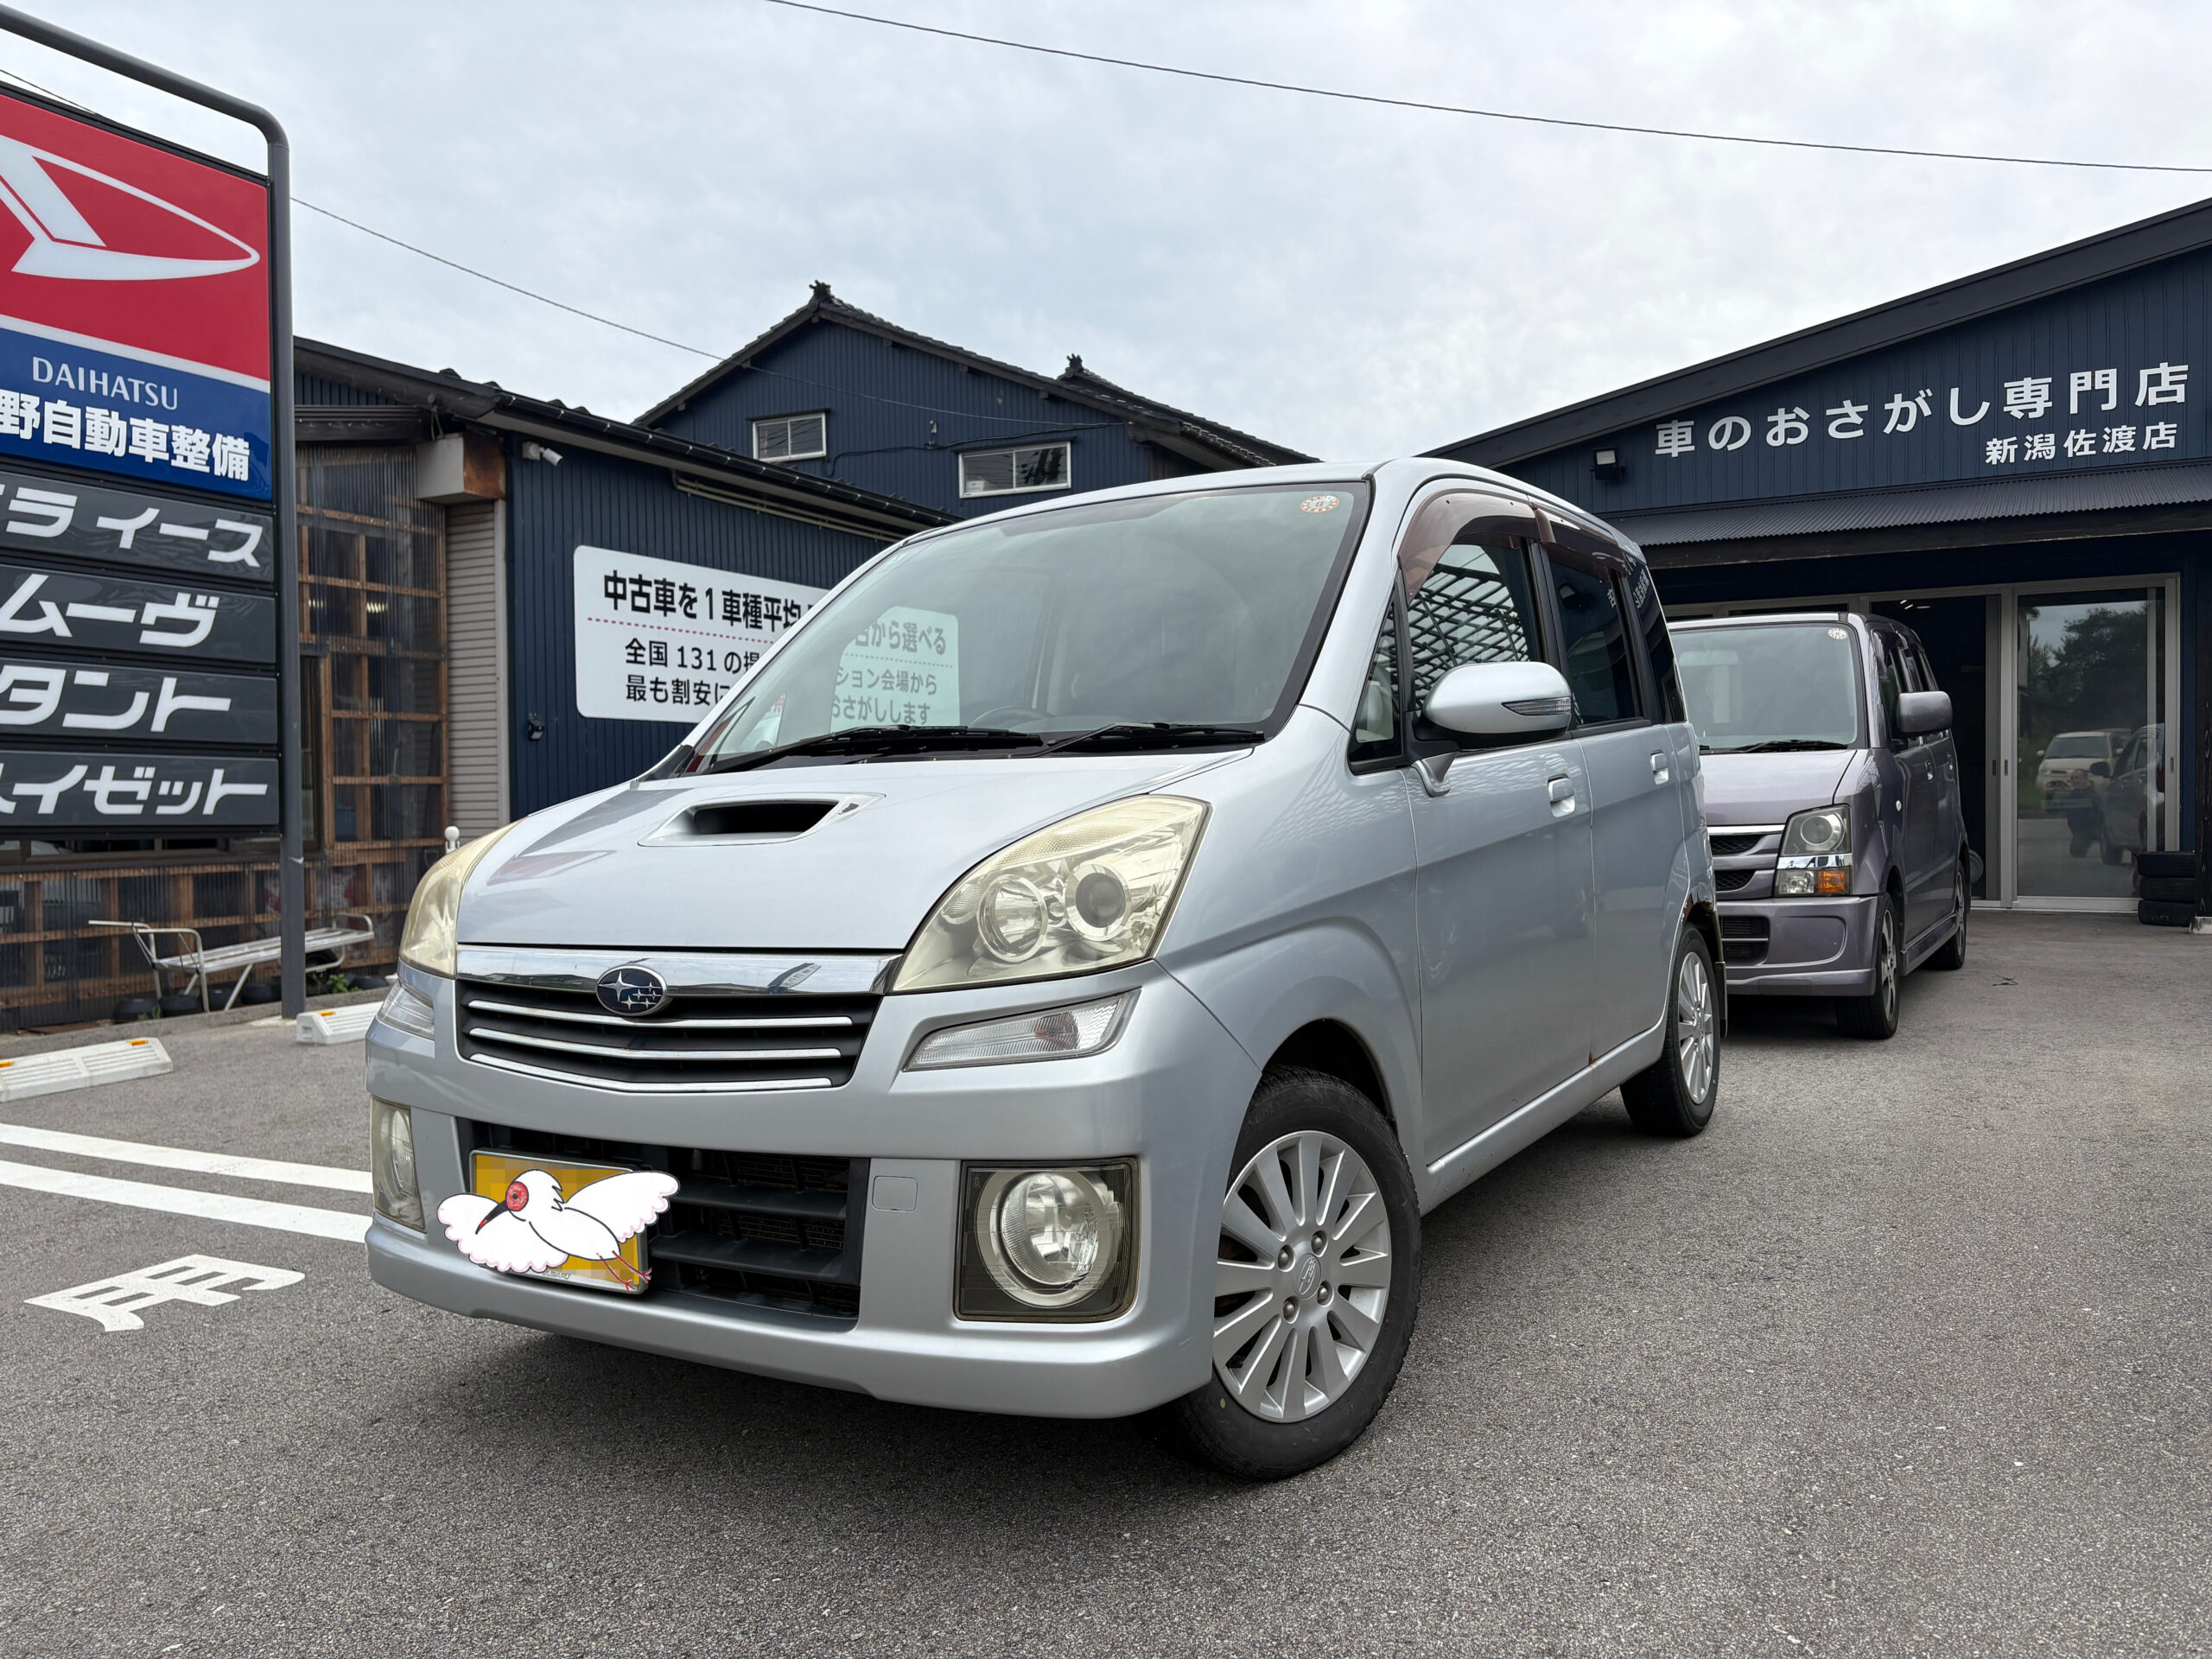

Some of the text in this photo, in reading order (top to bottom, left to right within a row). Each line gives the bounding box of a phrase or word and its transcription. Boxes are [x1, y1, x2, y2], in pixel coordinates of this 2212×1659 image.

[32, 356, 179, 411] DAIHATSU
[1655, 361, 2189, 458] 車のおさがし専門店
[0, 388, 251, 482] 野自動車整備
[1985, 421, 2177, 466] 新潟佐渡店
[0, 484, 264, 568] ライース
[0, 573, 220, 648] ムーヴ
[603, 569, 814, 632] 中古車を1車種平均
[0, 664, 232, 733] タント
